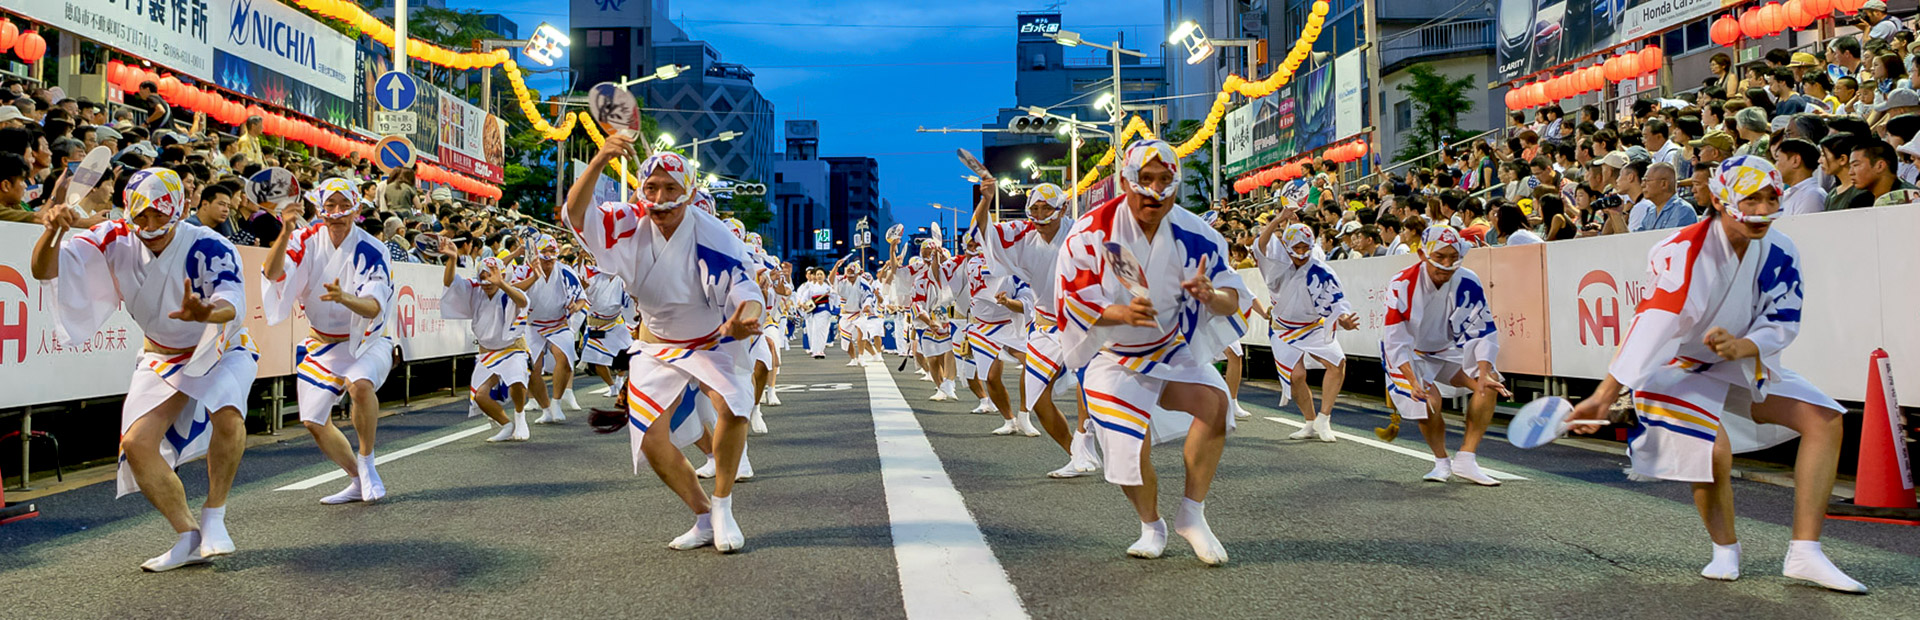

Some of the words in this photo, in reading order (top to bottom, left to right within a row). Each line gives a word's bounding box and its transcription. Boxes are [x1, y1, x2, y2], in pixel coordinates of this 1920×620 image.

[108, 0, 208, 45] 製作所
[1643, 1, 1671, 22] Honda
[252, 10, 316, 71] NICHIA
[1021, 23, 1059, 33] 白水園
[1499, 57, 1525, 74] CLARITY
[1492, 312, 1531, 339] います。
[1577, 296, 1620, 347] NH
